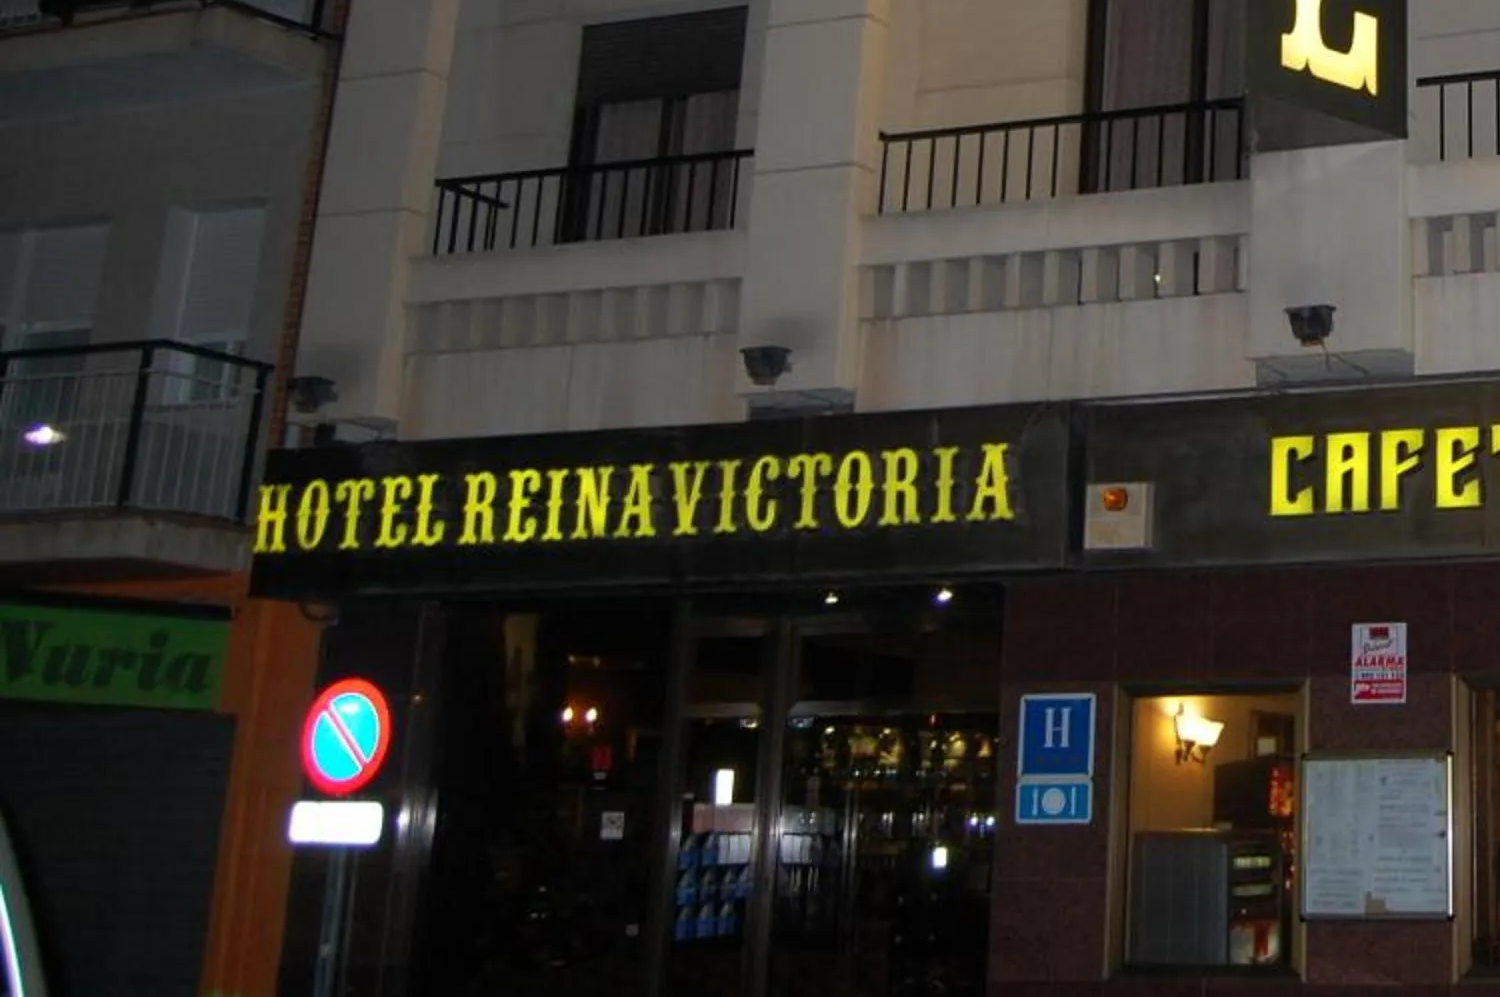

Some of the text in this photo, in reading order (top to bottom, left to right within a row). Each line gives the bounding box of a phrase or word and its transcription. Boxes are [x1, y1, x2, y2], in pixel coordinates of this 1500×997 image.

[253, 442, 1014, 553] HOTEL REINA VICTORIA
[1043, 706, 1072, 748] H
